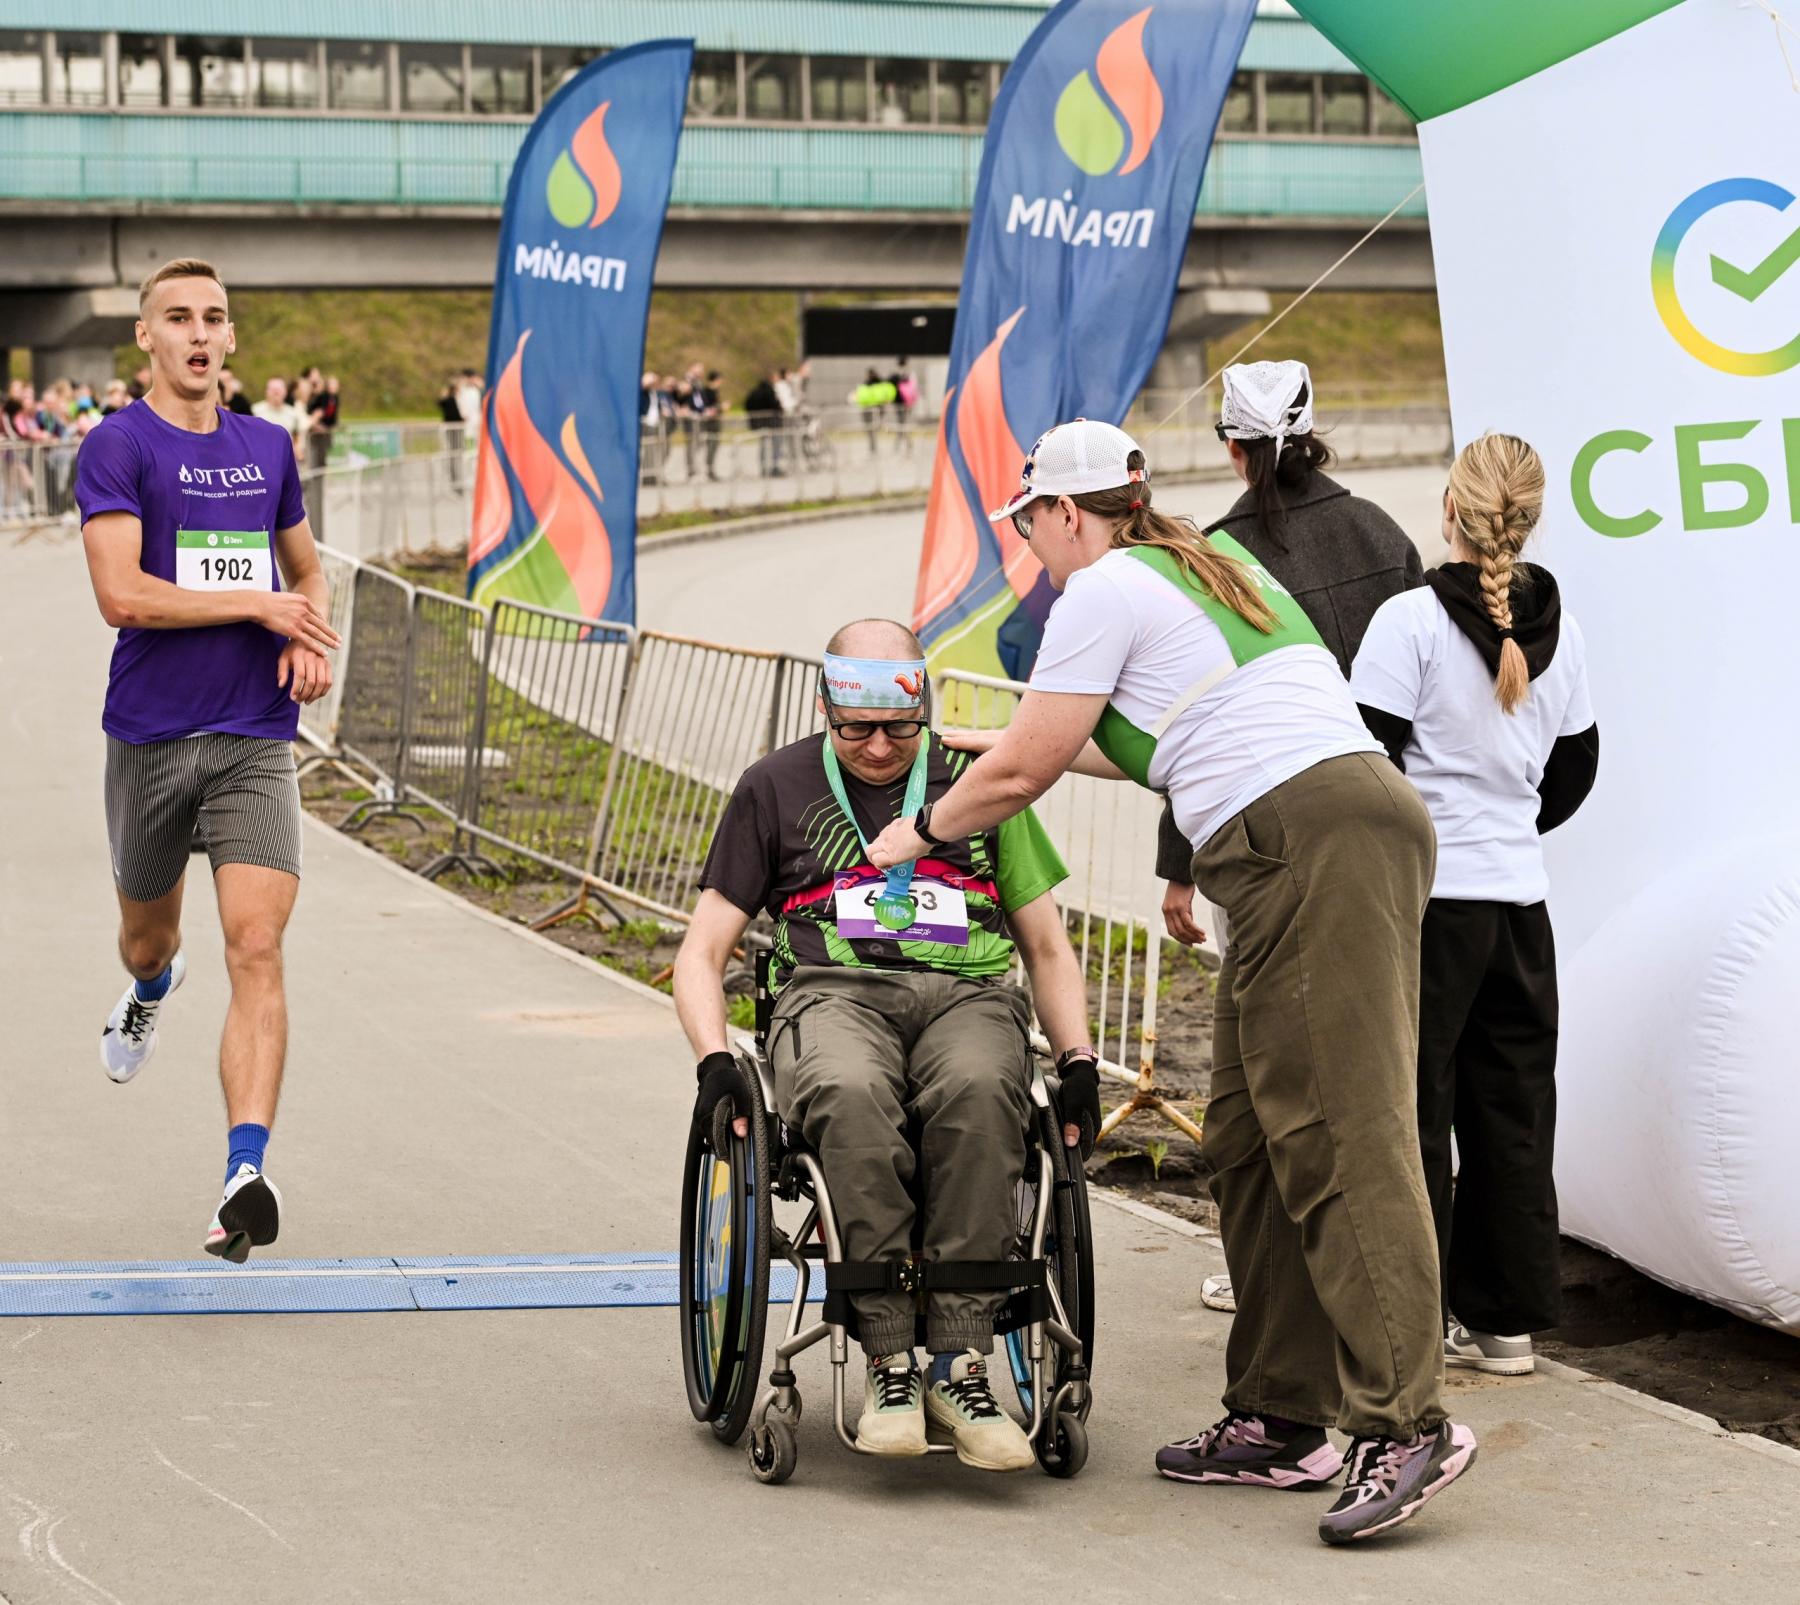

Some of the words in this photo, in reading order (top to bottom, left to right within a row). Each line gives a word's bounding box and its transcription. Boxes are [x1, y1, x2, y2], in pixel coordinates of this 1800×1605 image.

[1570, 418, 1800, 538] СБ
[200, 558, 253, 581] 1902
[864, 889, 938, 911] 653
